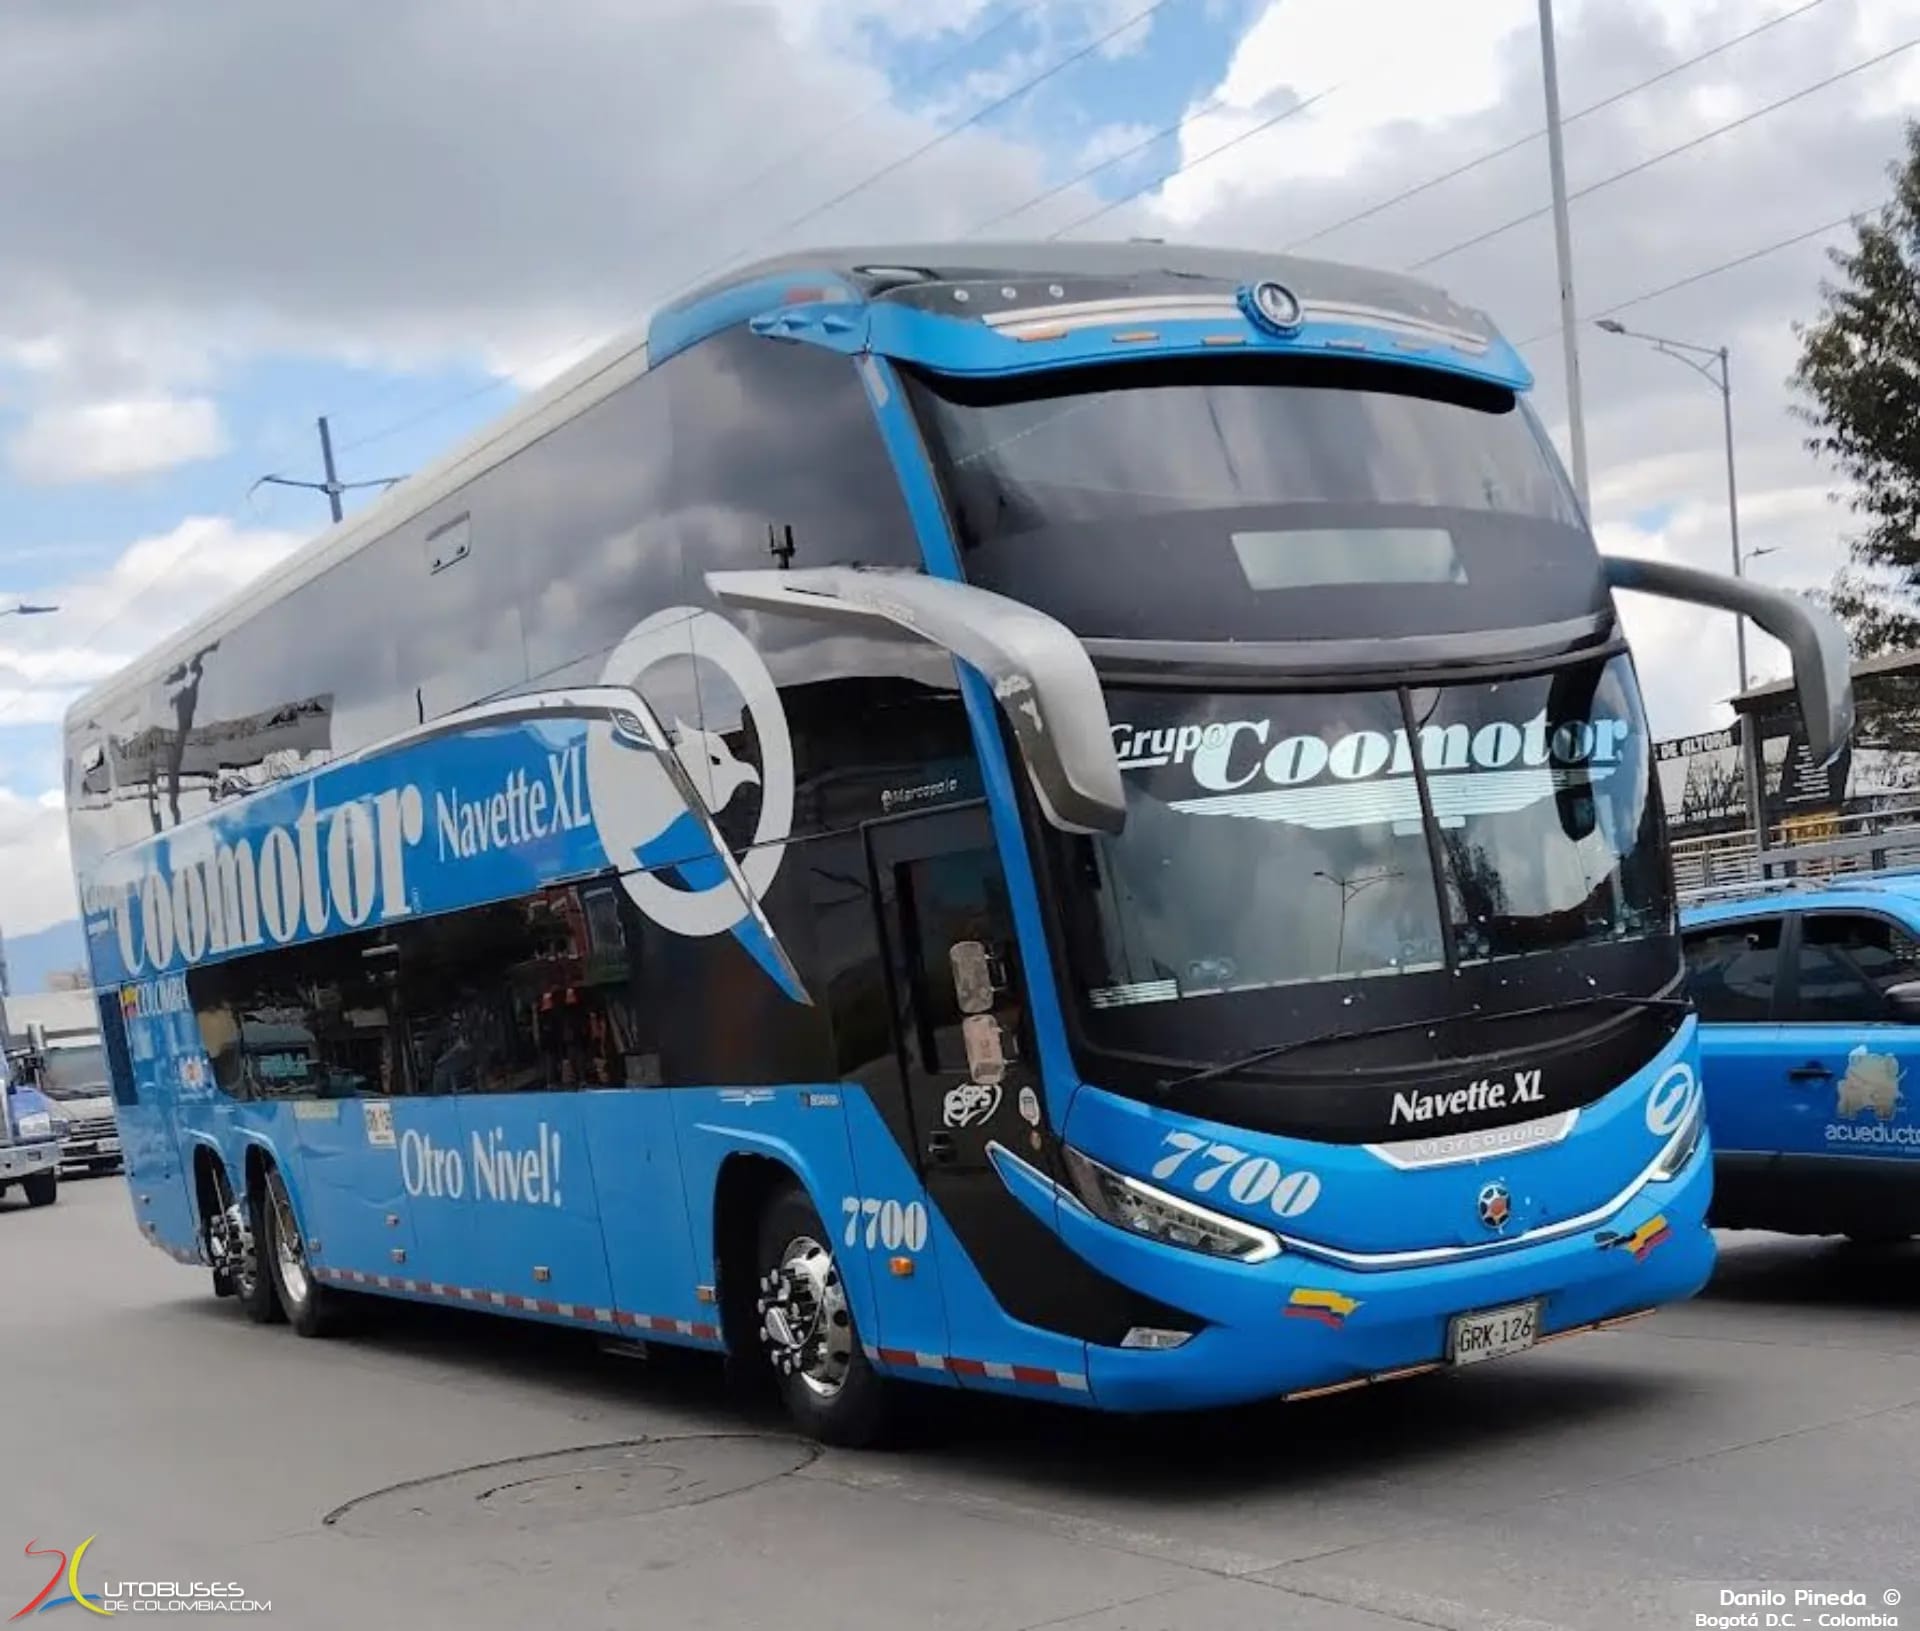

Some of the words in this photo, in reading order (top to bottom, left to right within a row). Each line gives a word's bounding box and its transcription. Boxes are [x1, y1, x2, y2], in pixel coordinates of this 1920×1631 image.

[1192, 710, 1629, 790] Coomotor
[436, 767, 548, 863] Navette
[548, 745, 591, 834] XL
[114, 778, 424, 976] Coomotor
[1390, 1079, 1506, 1125] Navette
[1511, 1069, 1546, 1104] XL
[401, 1128, 464, 1199] Otro
[472, 1121, 561, 1208] Nivel!
[1152, 1131, 1322, 1218] 7700
[842, 1196, 928, 1252] 7700
